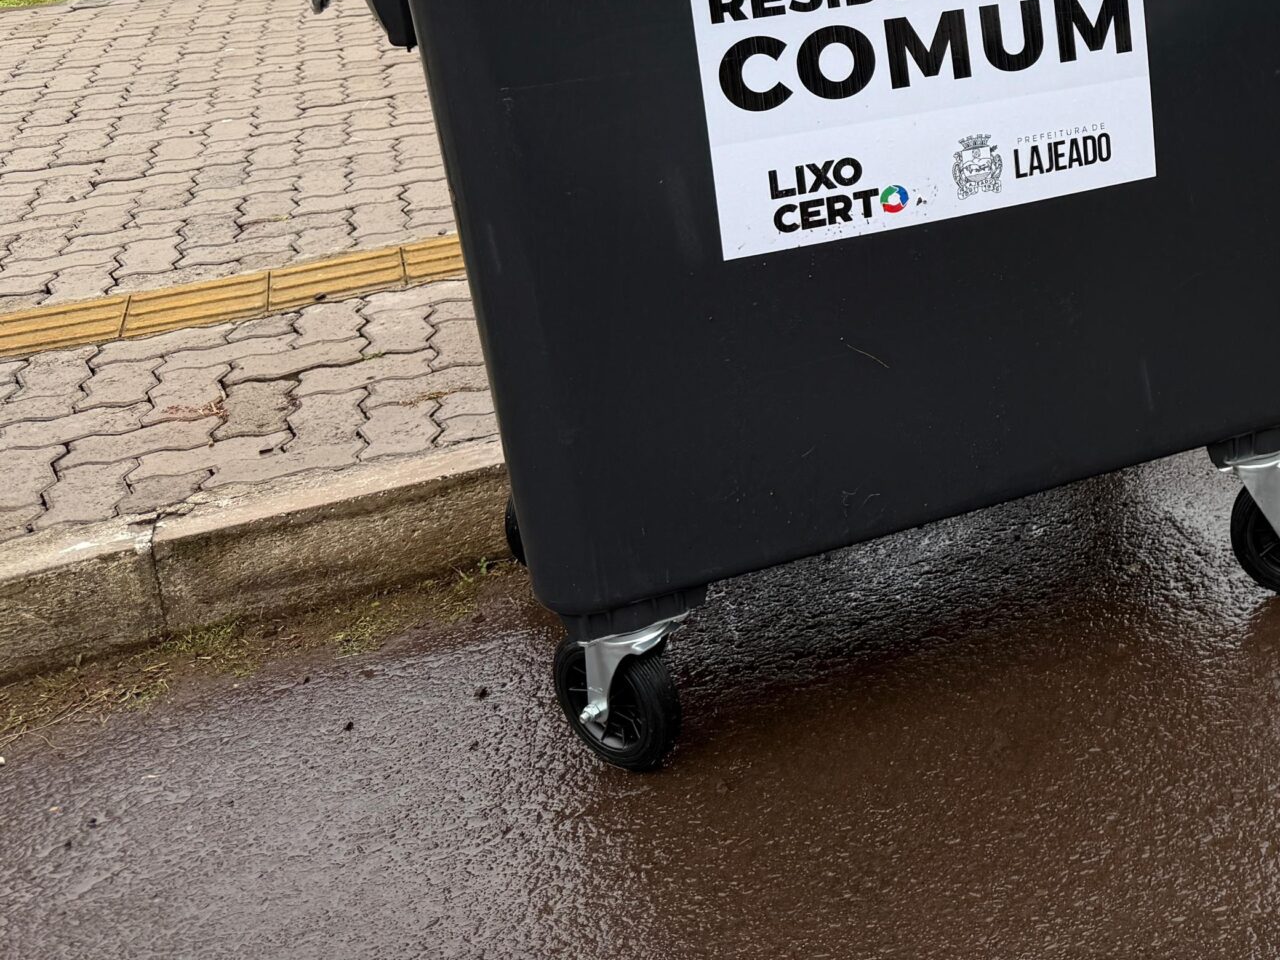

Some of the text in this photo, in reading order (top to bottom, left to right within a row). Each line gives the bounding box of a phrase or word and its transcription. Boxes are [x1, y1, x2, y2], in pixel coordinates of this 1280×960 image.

[1017, 122, 1106, 145] PREFEITURA DE
[1013, 133, 1112, 179] LAJEADO
[768, 157, 862, 200] LIXO
